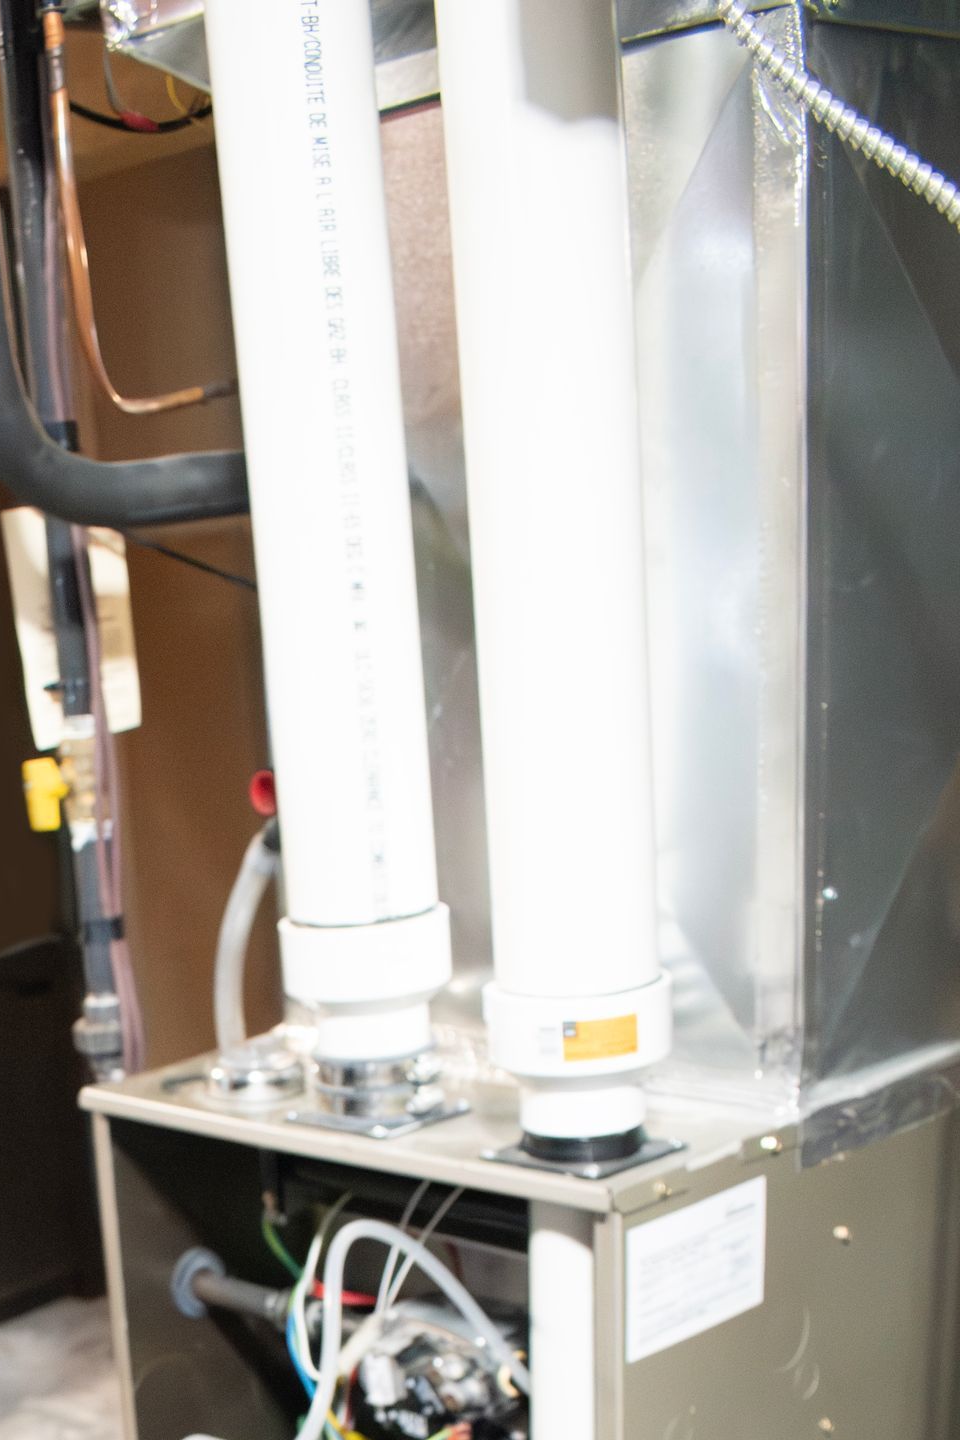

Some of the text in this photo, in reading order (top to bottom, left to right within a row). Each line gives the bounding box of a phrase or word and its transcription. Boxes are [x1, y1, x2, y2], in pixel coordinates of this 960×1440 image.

[310, 112, 326, 129] DE
[312, 136, 329, 169] MISE
[321, 238, 340, 278] LIBRE
[325, 286, 343, 310] DES
